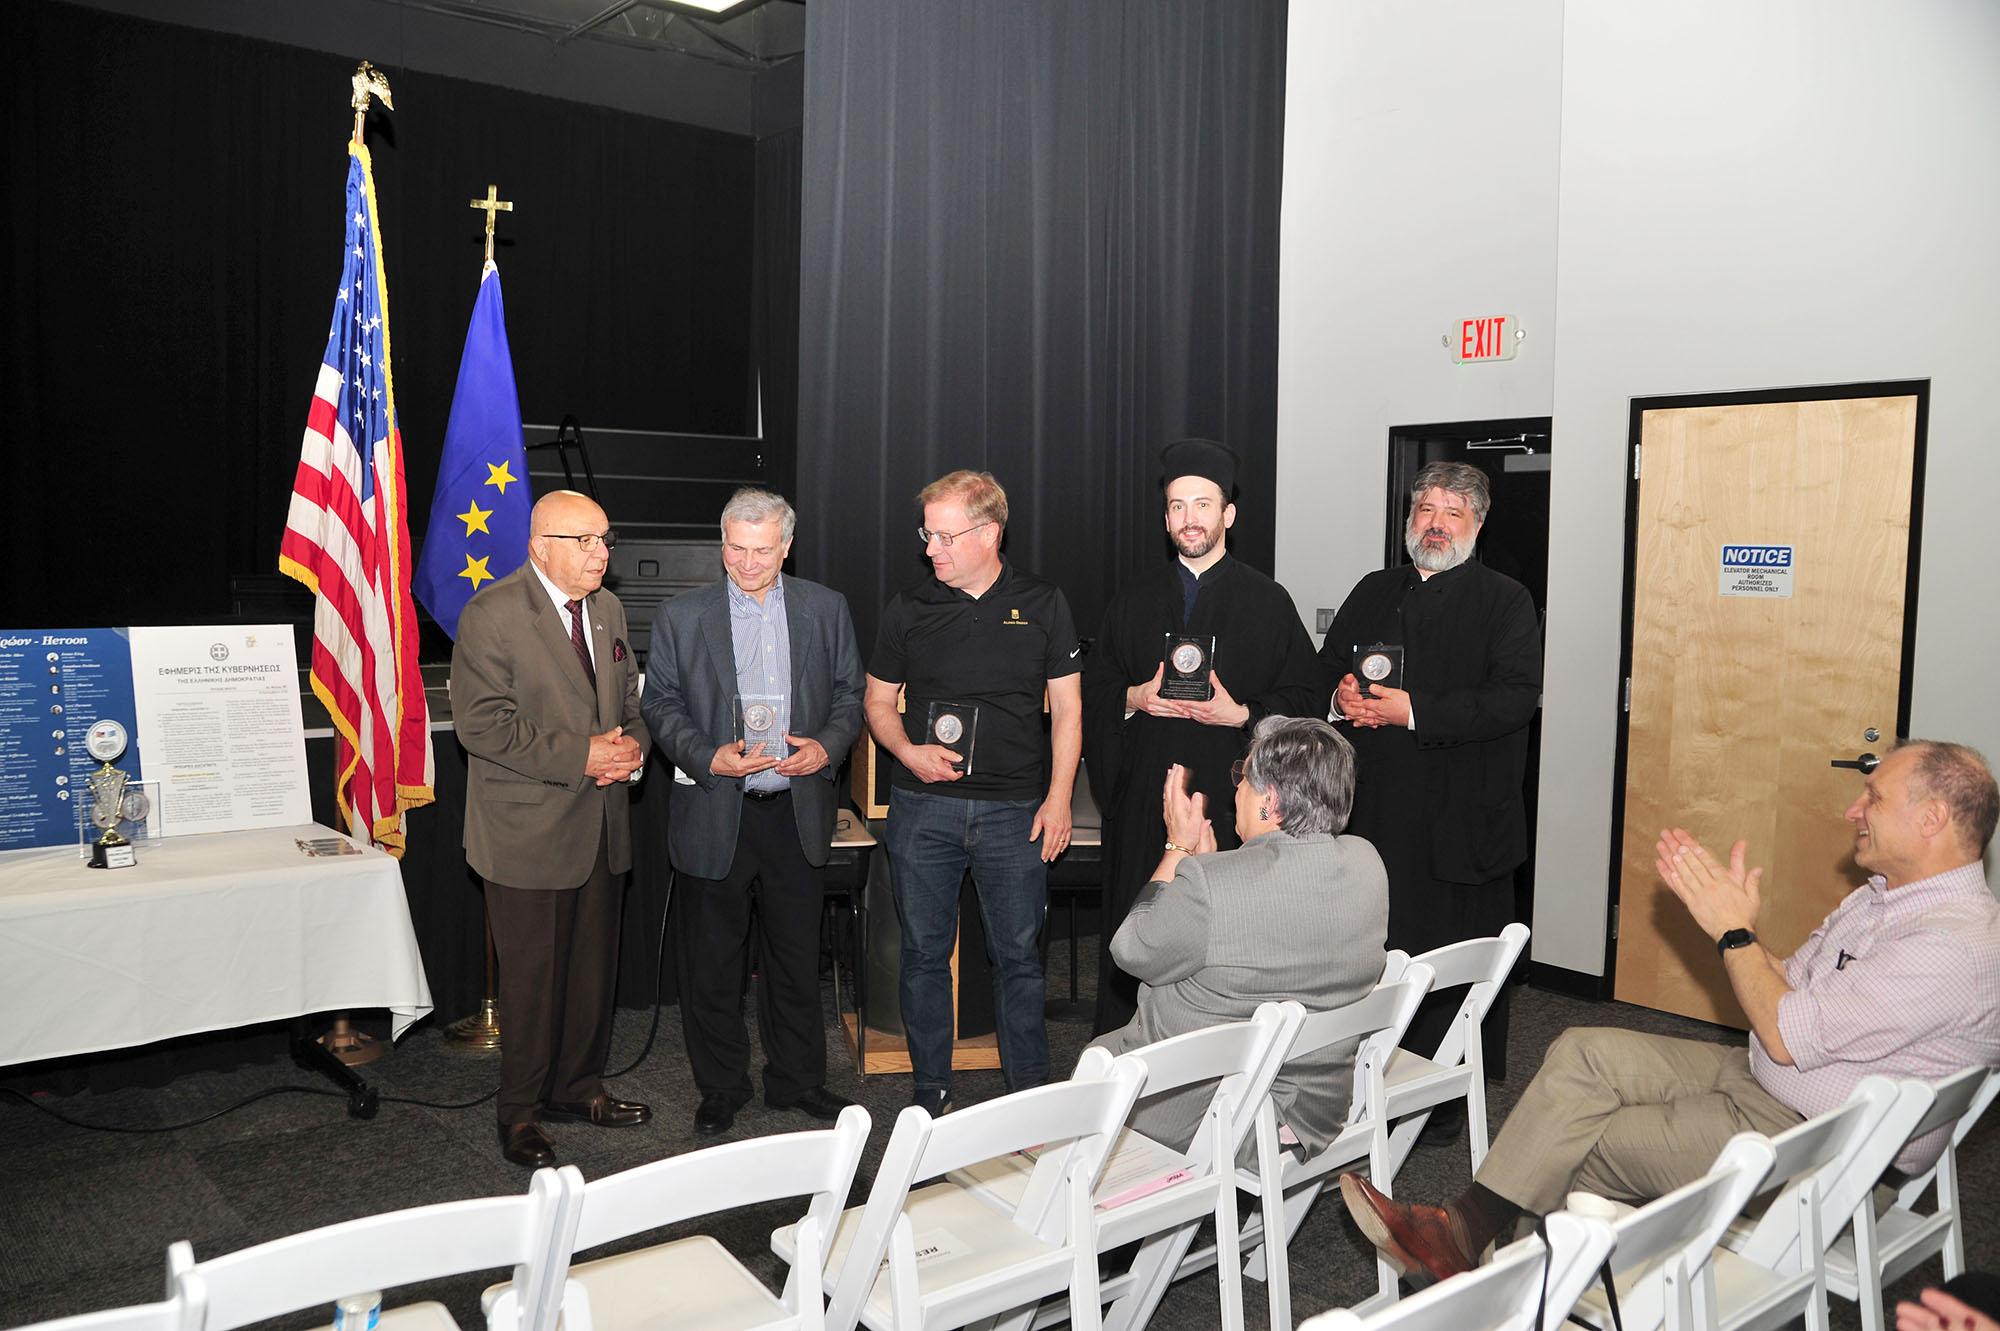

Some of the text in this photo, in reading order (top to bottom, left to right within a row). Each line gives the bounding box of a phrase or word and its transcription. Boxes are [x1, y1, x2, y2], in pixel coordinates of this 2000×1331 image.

[1462, 317, 1505, 359] EXIT
[1725, 549, 1790, 564] NOTICE
[0, 636, 32, 649] ρώον
[41, 635, 88, 646] Heroon
[158, 664, 281, 675] ΕΦΗΜΕΡΙΣ ΤΗΣ ΚΥΒΕΡΝΗΣΕΩΣ
